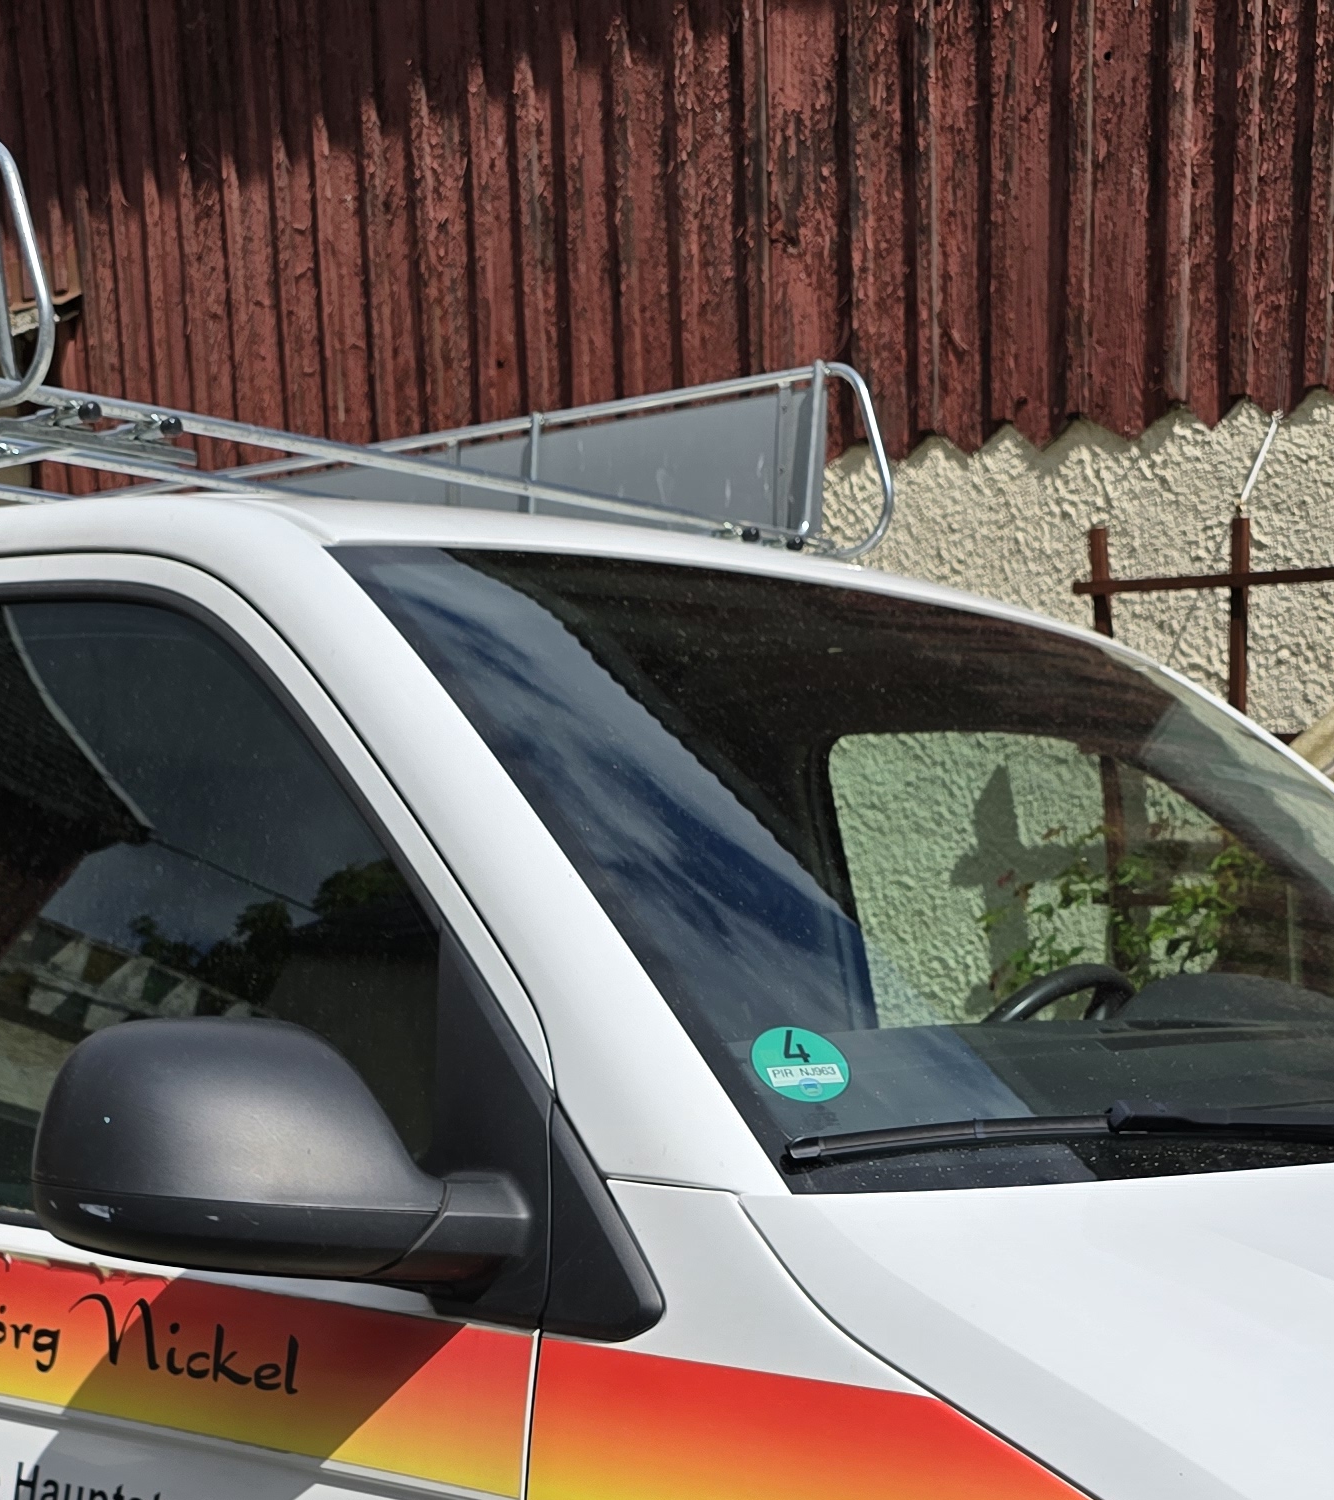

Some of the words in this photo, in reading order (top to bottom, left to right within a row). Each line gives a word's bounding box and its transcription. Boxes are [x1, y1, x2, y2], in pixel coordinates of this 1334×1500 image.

[782, 1029, 811, 1063] 4
[771, 1067, 795, 1080] PIR
[68, 1293, 300, 1395] Nickel
